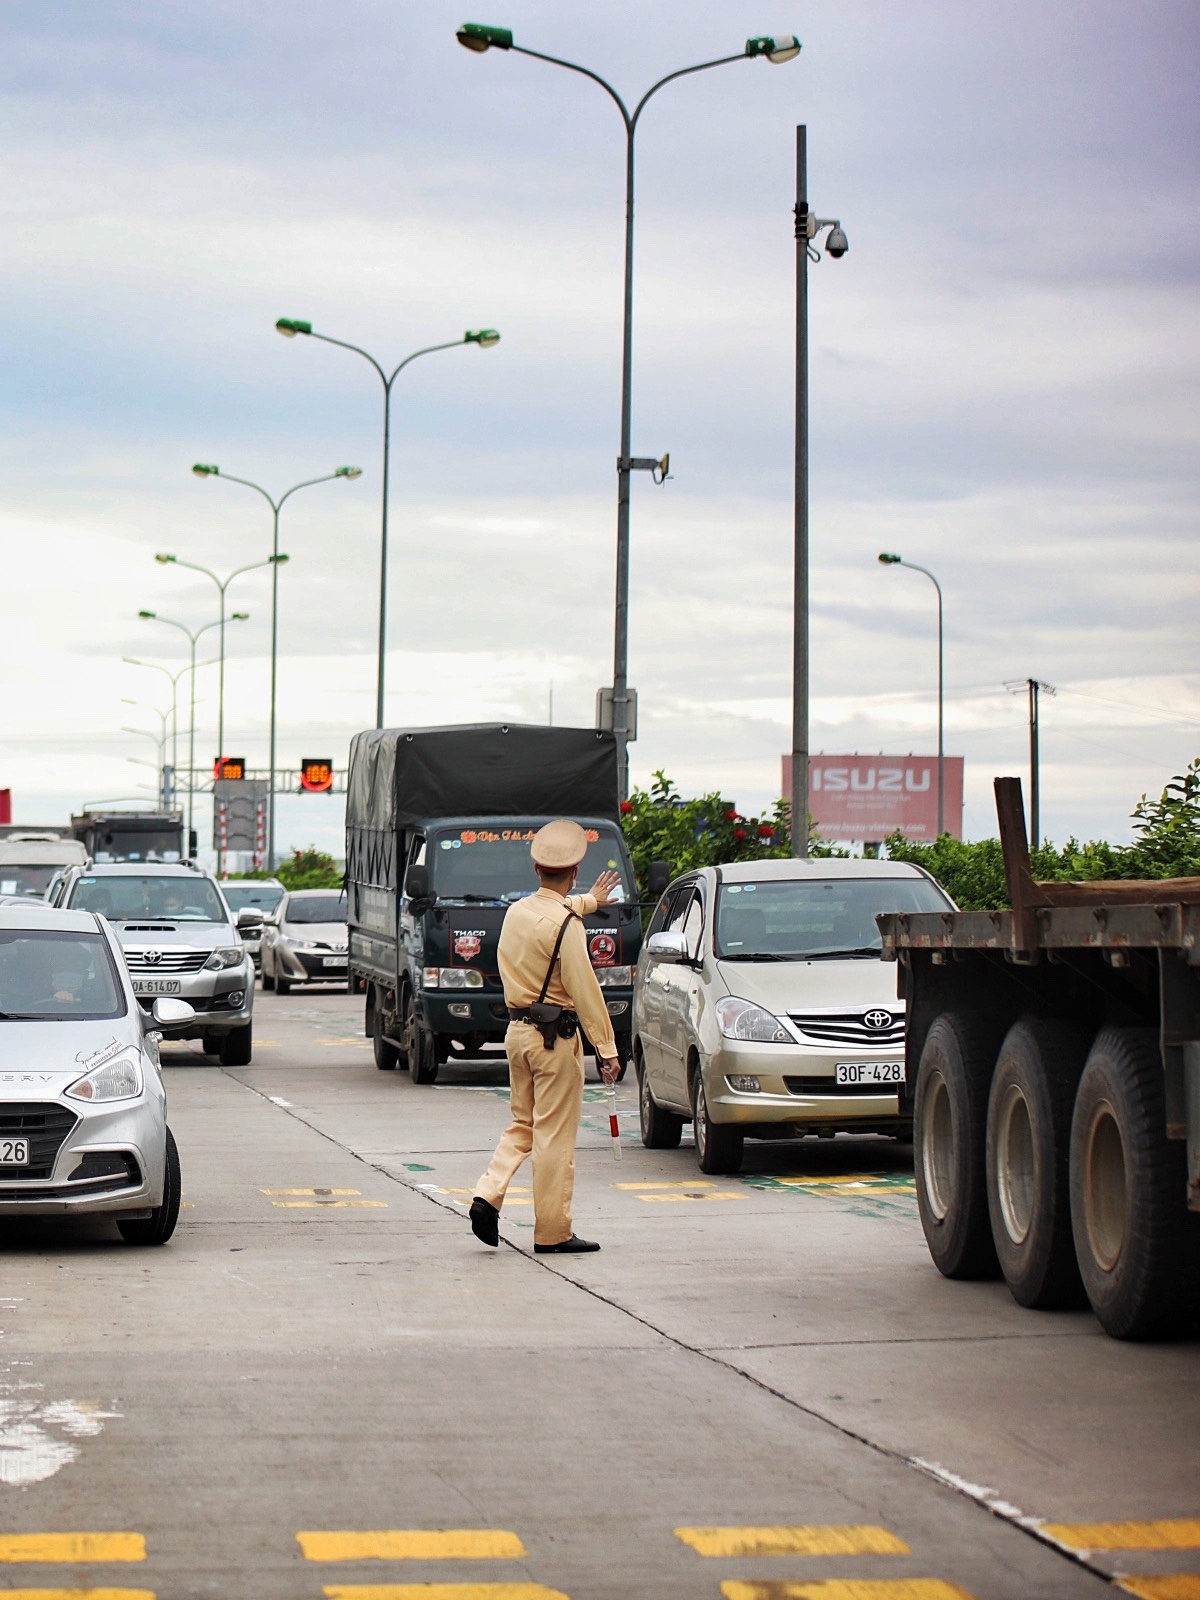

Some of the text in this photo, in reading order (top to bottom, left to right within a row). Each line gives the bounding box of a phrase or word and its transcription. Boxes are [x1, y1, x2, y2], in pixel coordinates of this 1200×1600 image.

[812, 768, 931, 792] ISUZU
[131, 981, 179, 992] 0A-614.07
[839, 1064, 905, 1082] 30F-428.
